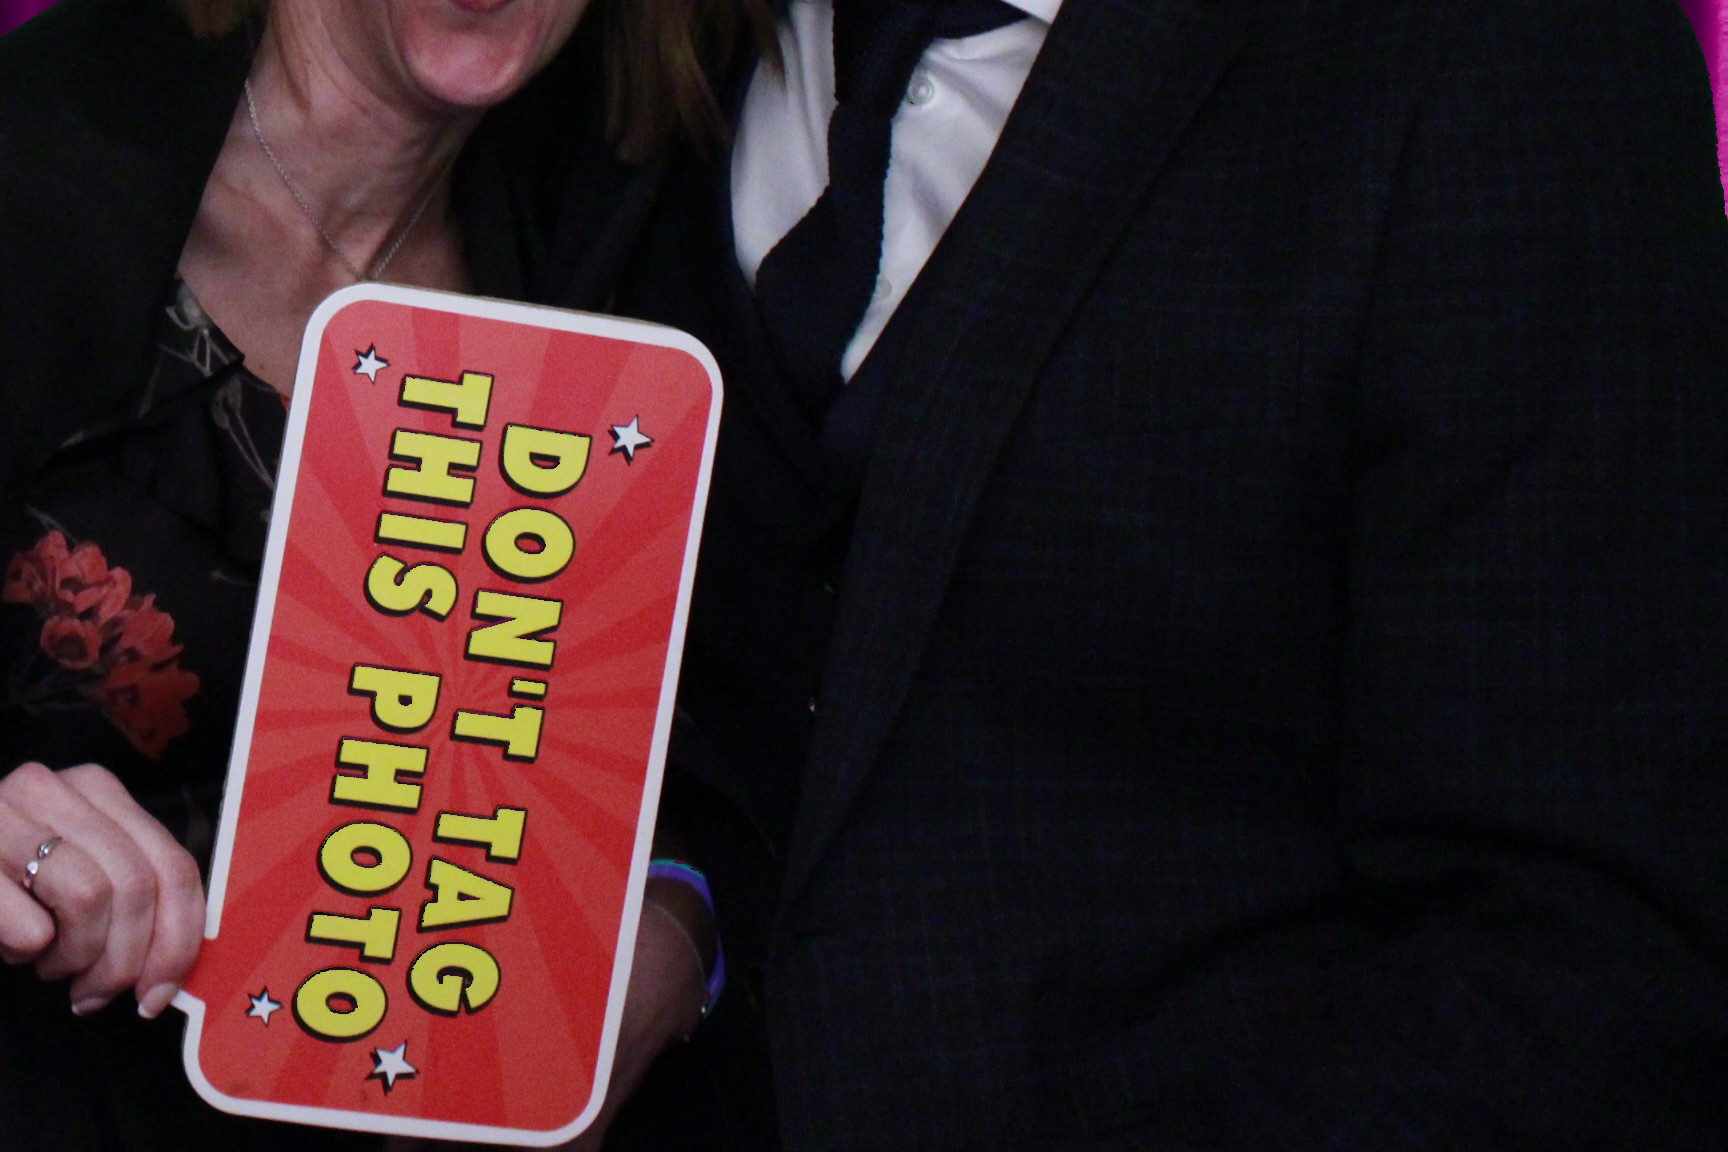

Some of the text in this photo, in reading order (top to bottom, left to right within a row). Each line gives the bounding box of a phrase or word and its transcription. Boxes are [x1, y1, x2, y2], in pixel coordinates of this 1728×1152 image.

[292, 371, 494, 1041] THIS PHOTO
[407, 423, 592, 1016] DON'T TAG
